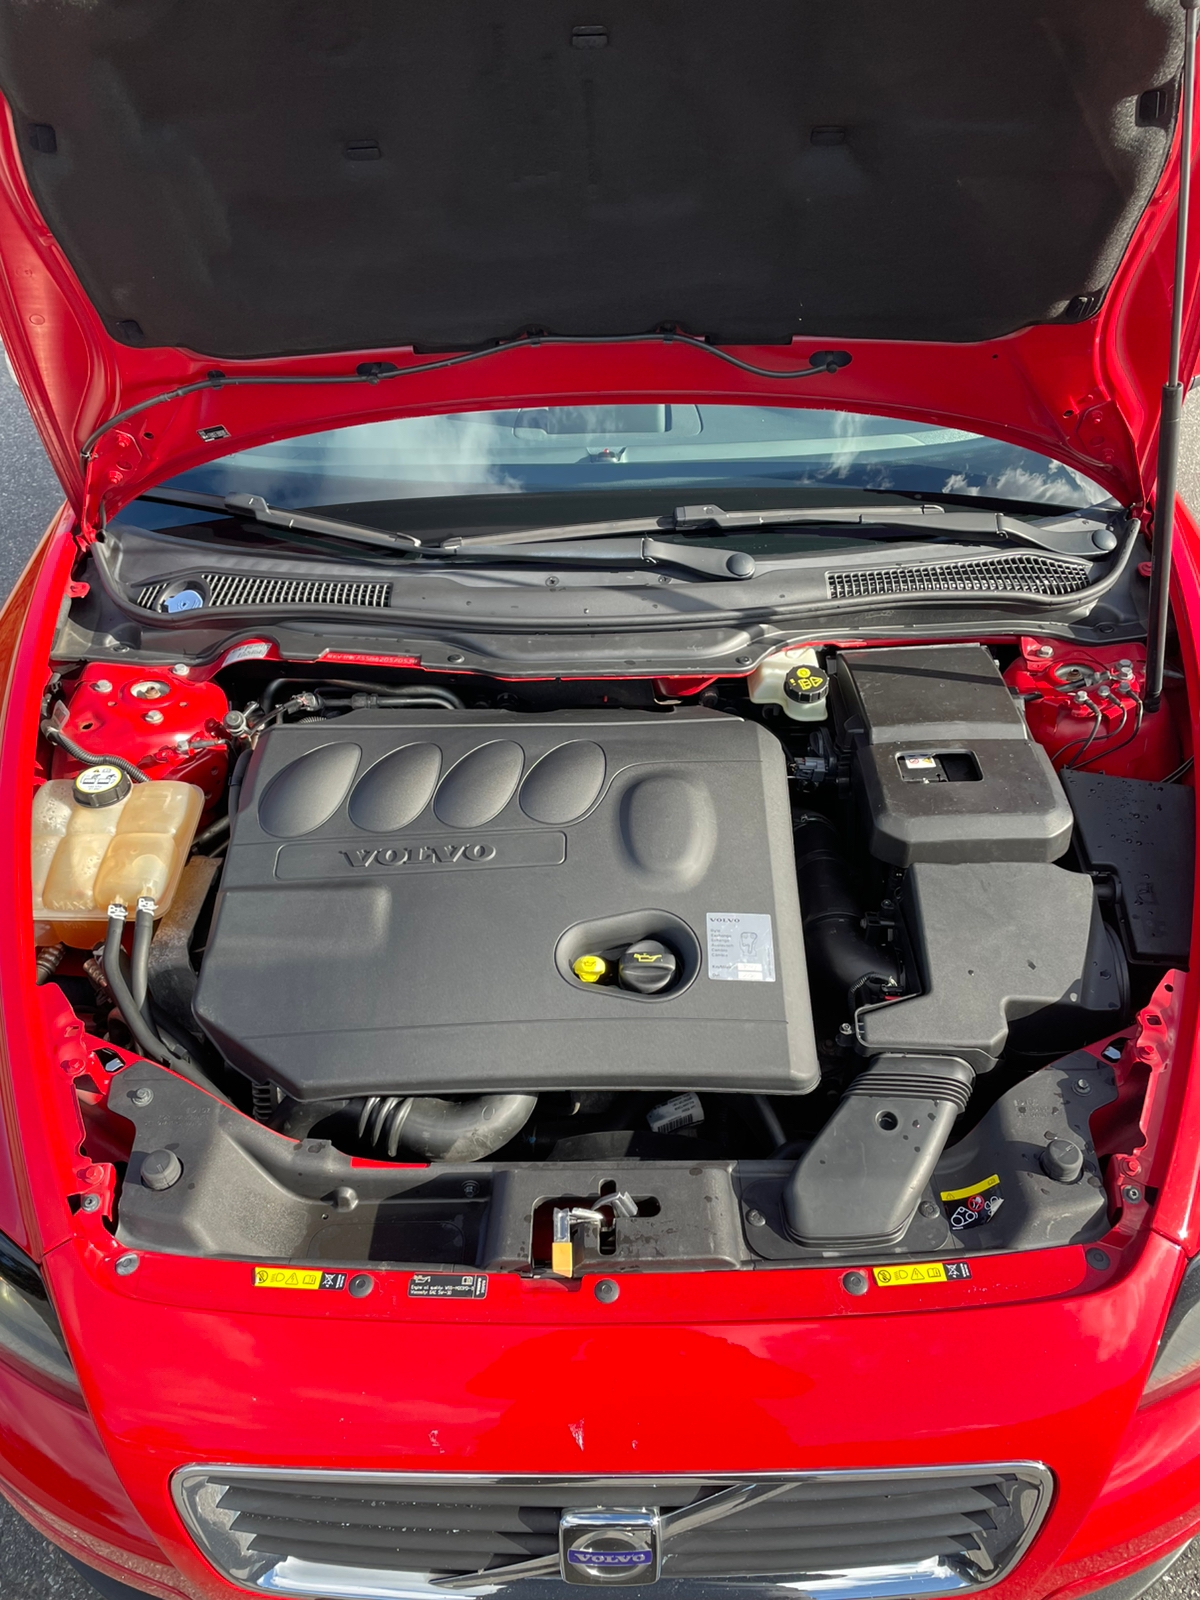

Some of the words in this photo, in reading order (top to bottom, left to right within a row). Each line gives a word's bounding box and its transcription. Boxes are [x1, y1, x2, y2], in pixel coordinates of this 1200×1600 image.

[338, 843, 497, 868] VOLVO
[53, 899, 86, 911] MAX
[573, 1552, 646, 1563] VOLVO
